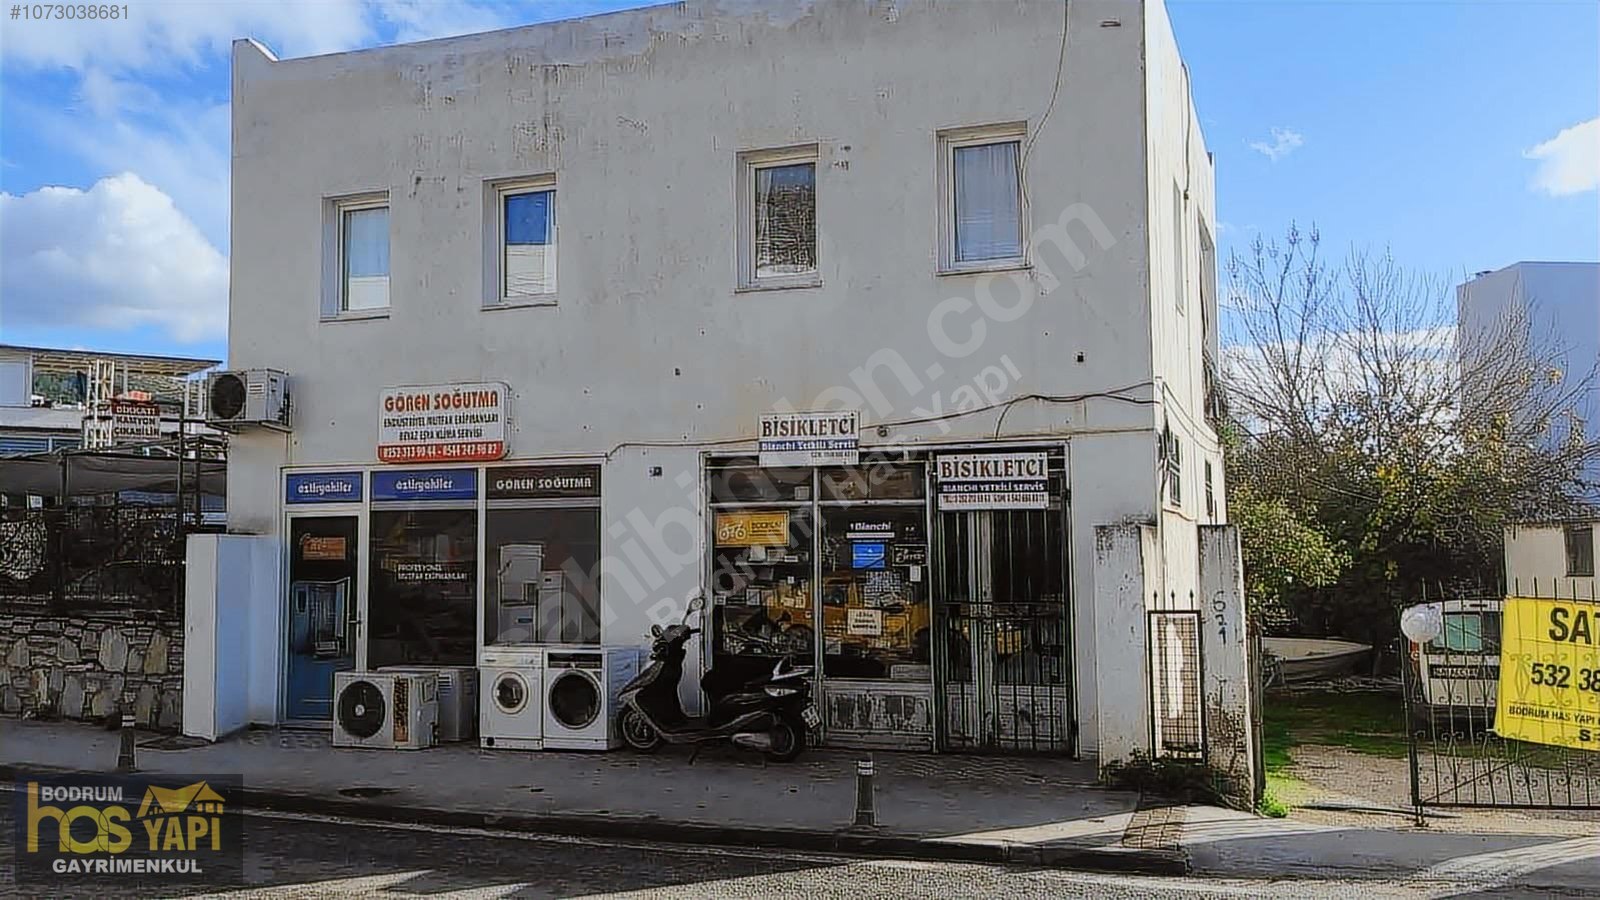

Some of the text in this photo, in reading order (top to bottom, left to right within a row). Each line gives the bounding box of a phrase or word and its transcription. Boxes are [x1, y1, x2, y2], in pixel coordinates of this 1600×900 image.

[384, 388, 498, 412] GÖREN SOĞUTMA
[762, 442, 796, 450] Bianchi
[855, 522, 892, 531] Bianchi
[1531, 662, 1571, 688] 532
[1509, 706, 1549, 719] BODRUM
[1552, 711, 1571, 721] HAS
[1574, 713, 1595, 725] YAPI
